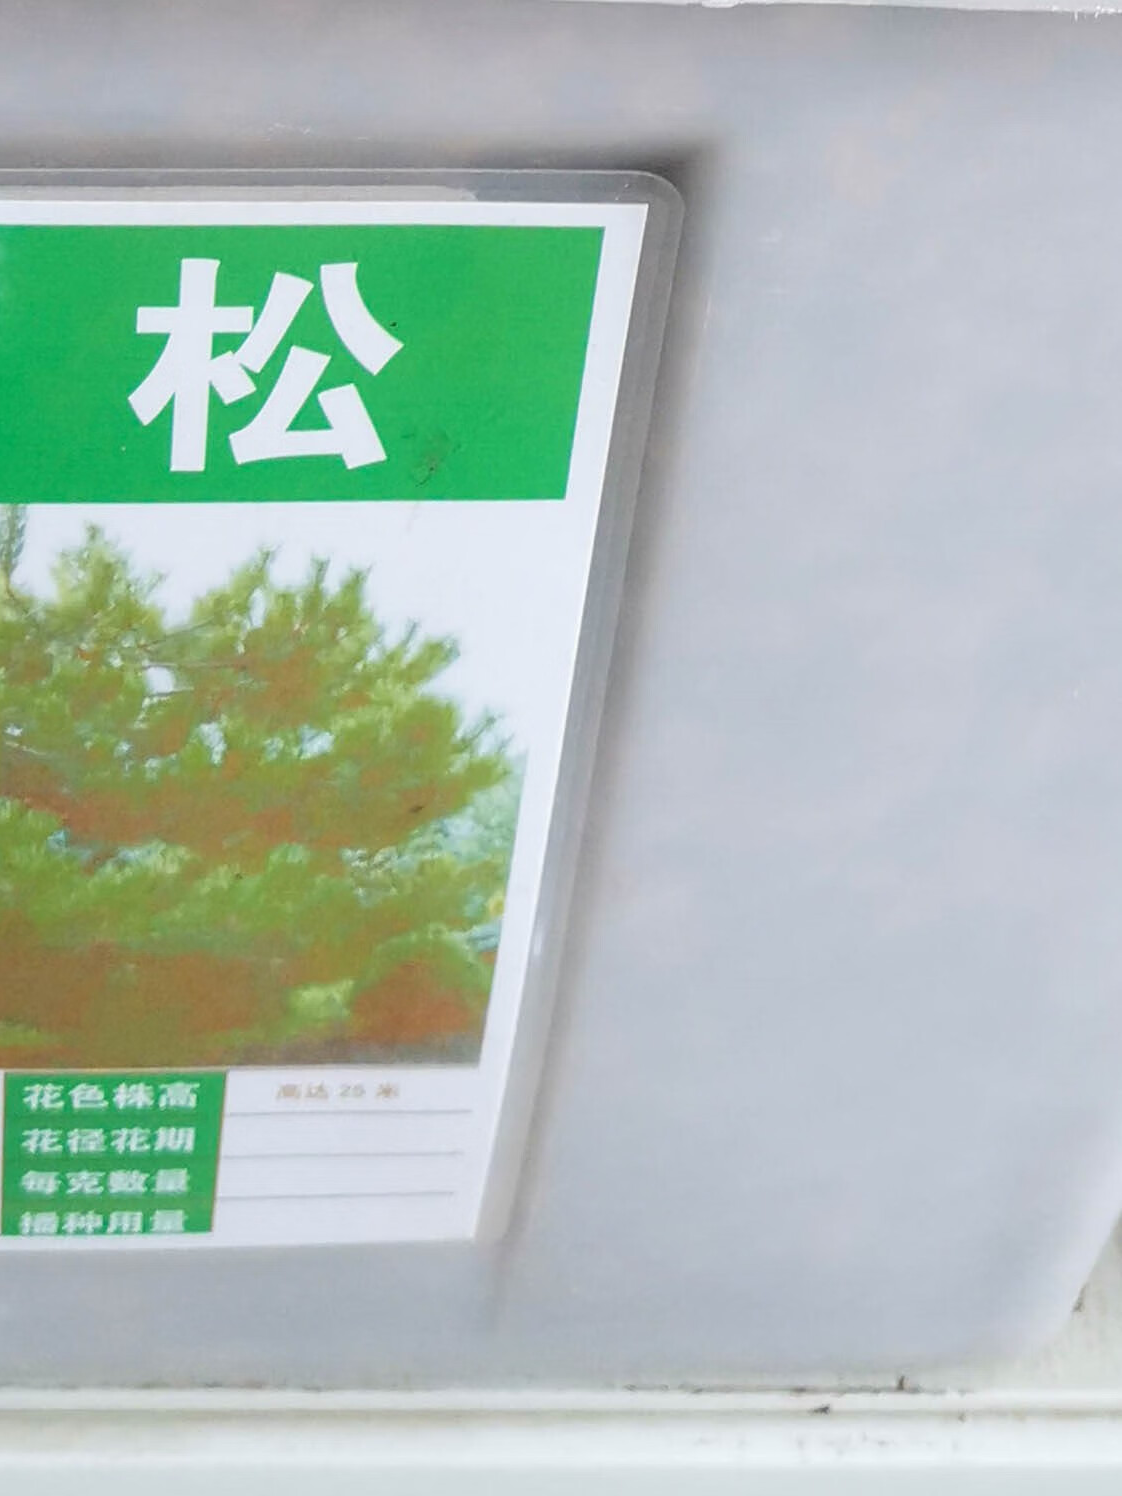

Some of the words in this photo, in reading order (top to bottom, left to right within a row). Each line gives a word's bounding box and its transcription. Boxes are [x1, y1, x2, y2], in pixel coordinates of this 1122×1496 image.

[23, 1081, 200, 1112] 花色株高
[21, 1126, 196, 1155] 花径花期
[20, 1168, 190, 1196] 每克数量
[19, 1209, 187, 1235] 播种用量
